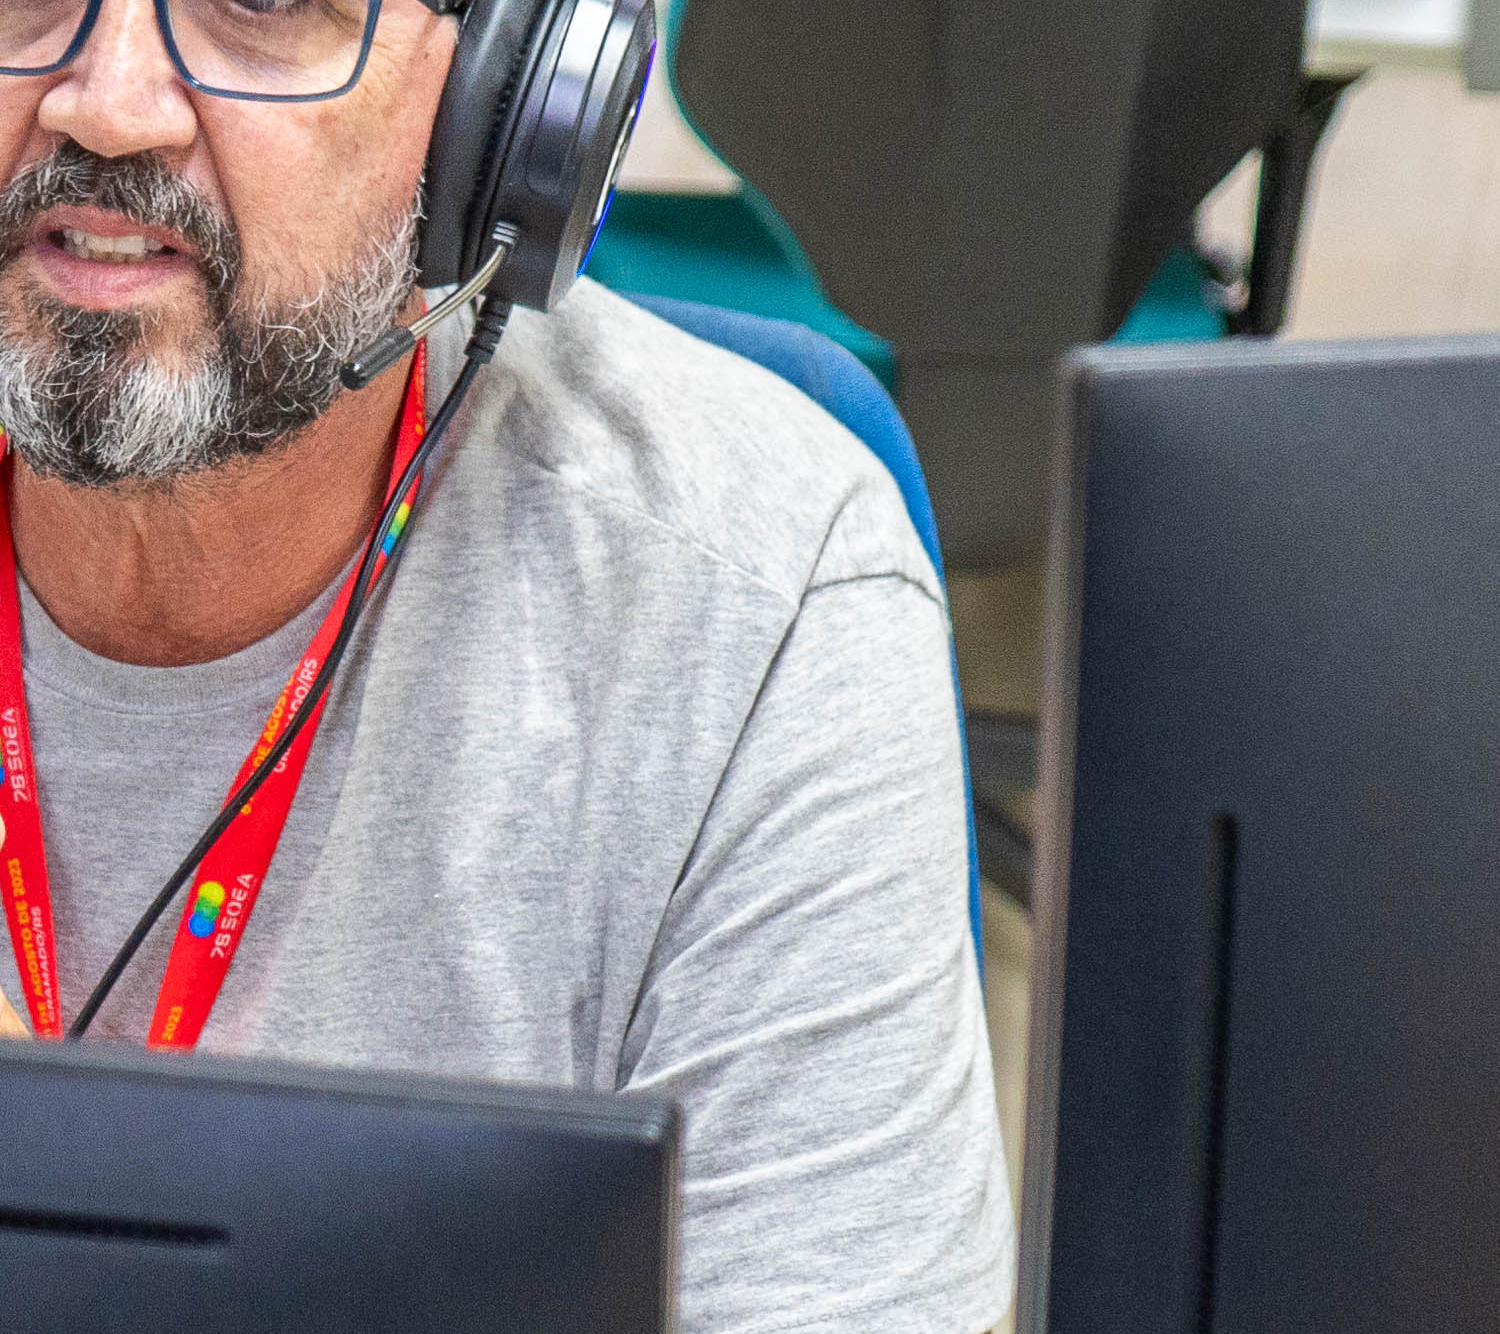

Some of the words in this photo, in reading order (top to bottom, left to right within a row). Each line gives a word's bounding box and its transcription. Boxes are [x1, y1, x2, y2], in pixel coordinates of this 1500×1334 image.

[1, 707, 23, 770] SOEA
[8, 858, 25, 897] 2023
[15, 900, 30, 925] DE
[220, 873, 254, 931] SOEA
[21, 928, 43, 997] AGOSTO
[30, 906, 55, 1022] GRAMADO/RS
[37, 1001, 49, 1024] DE
[162, 1005, 183, 1041] 2023
